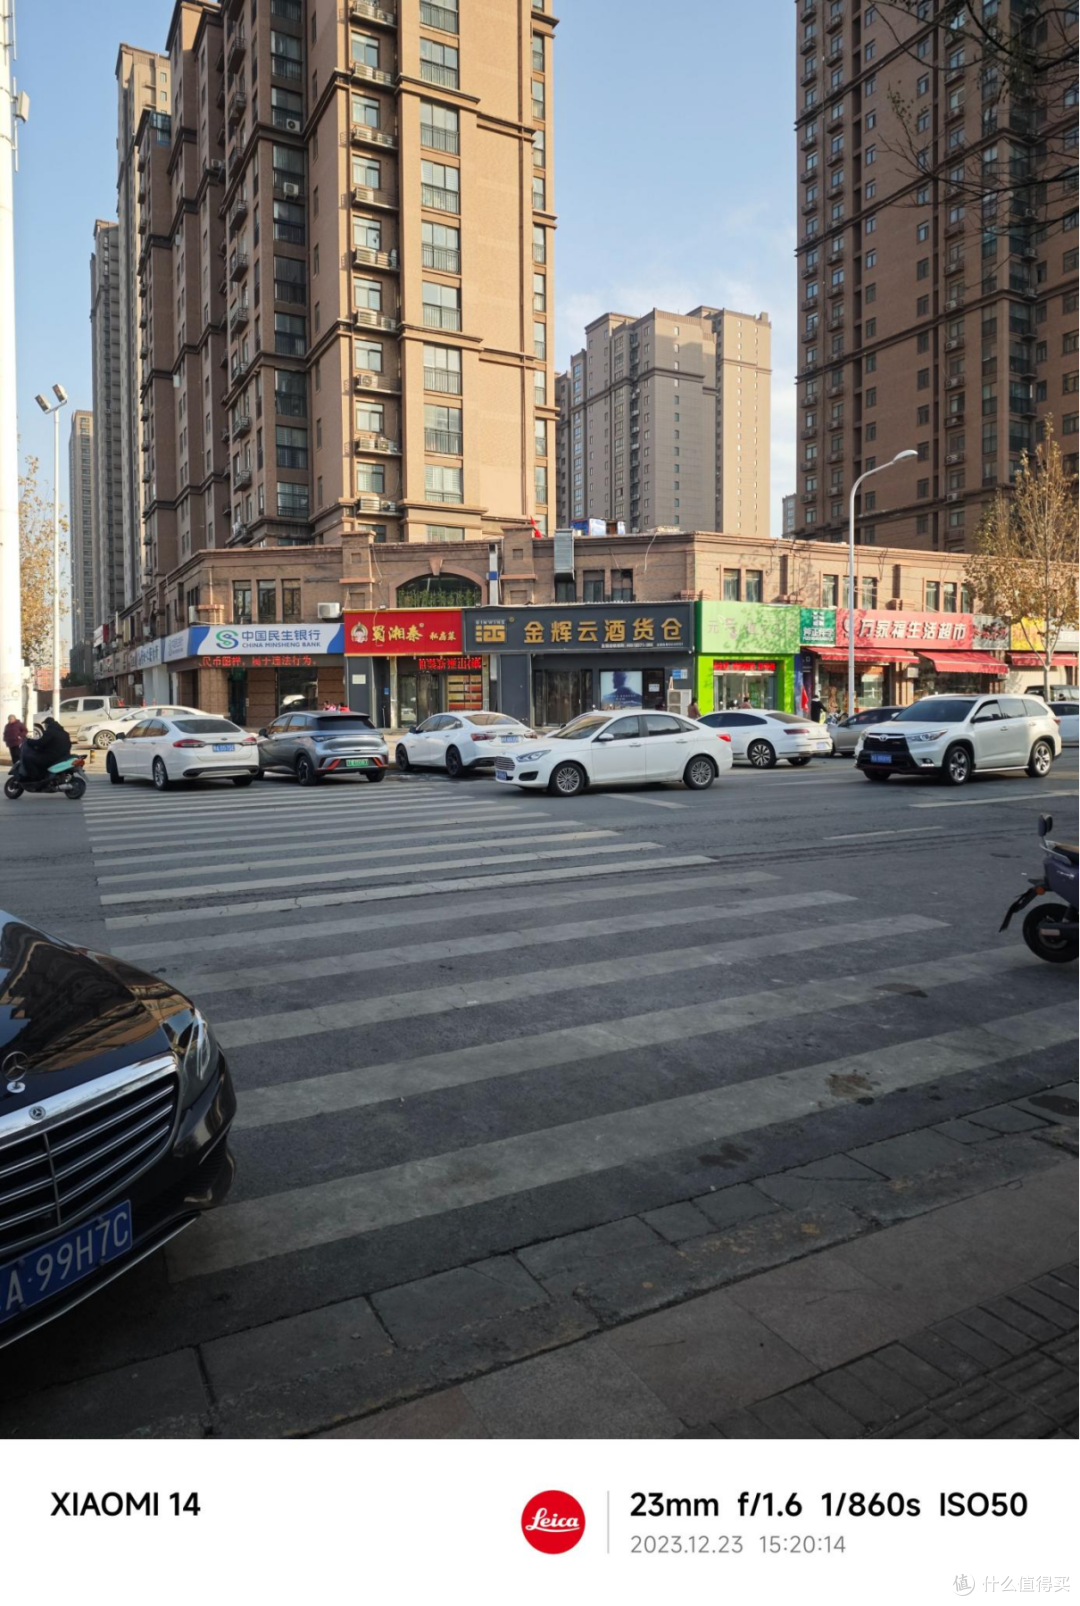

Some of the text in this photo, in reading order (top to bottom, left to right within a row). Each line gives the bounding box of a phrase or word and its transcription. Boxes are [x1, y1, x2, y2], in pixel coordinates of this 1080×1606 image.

[241, 629, 321, 642] 中国民生银行
[523, 617, 683, 643] 金辉云酒货仓
[859, 619, 966, 640] 万家福生活超市
[0, 1211, 129, 1311] A·99H7C
